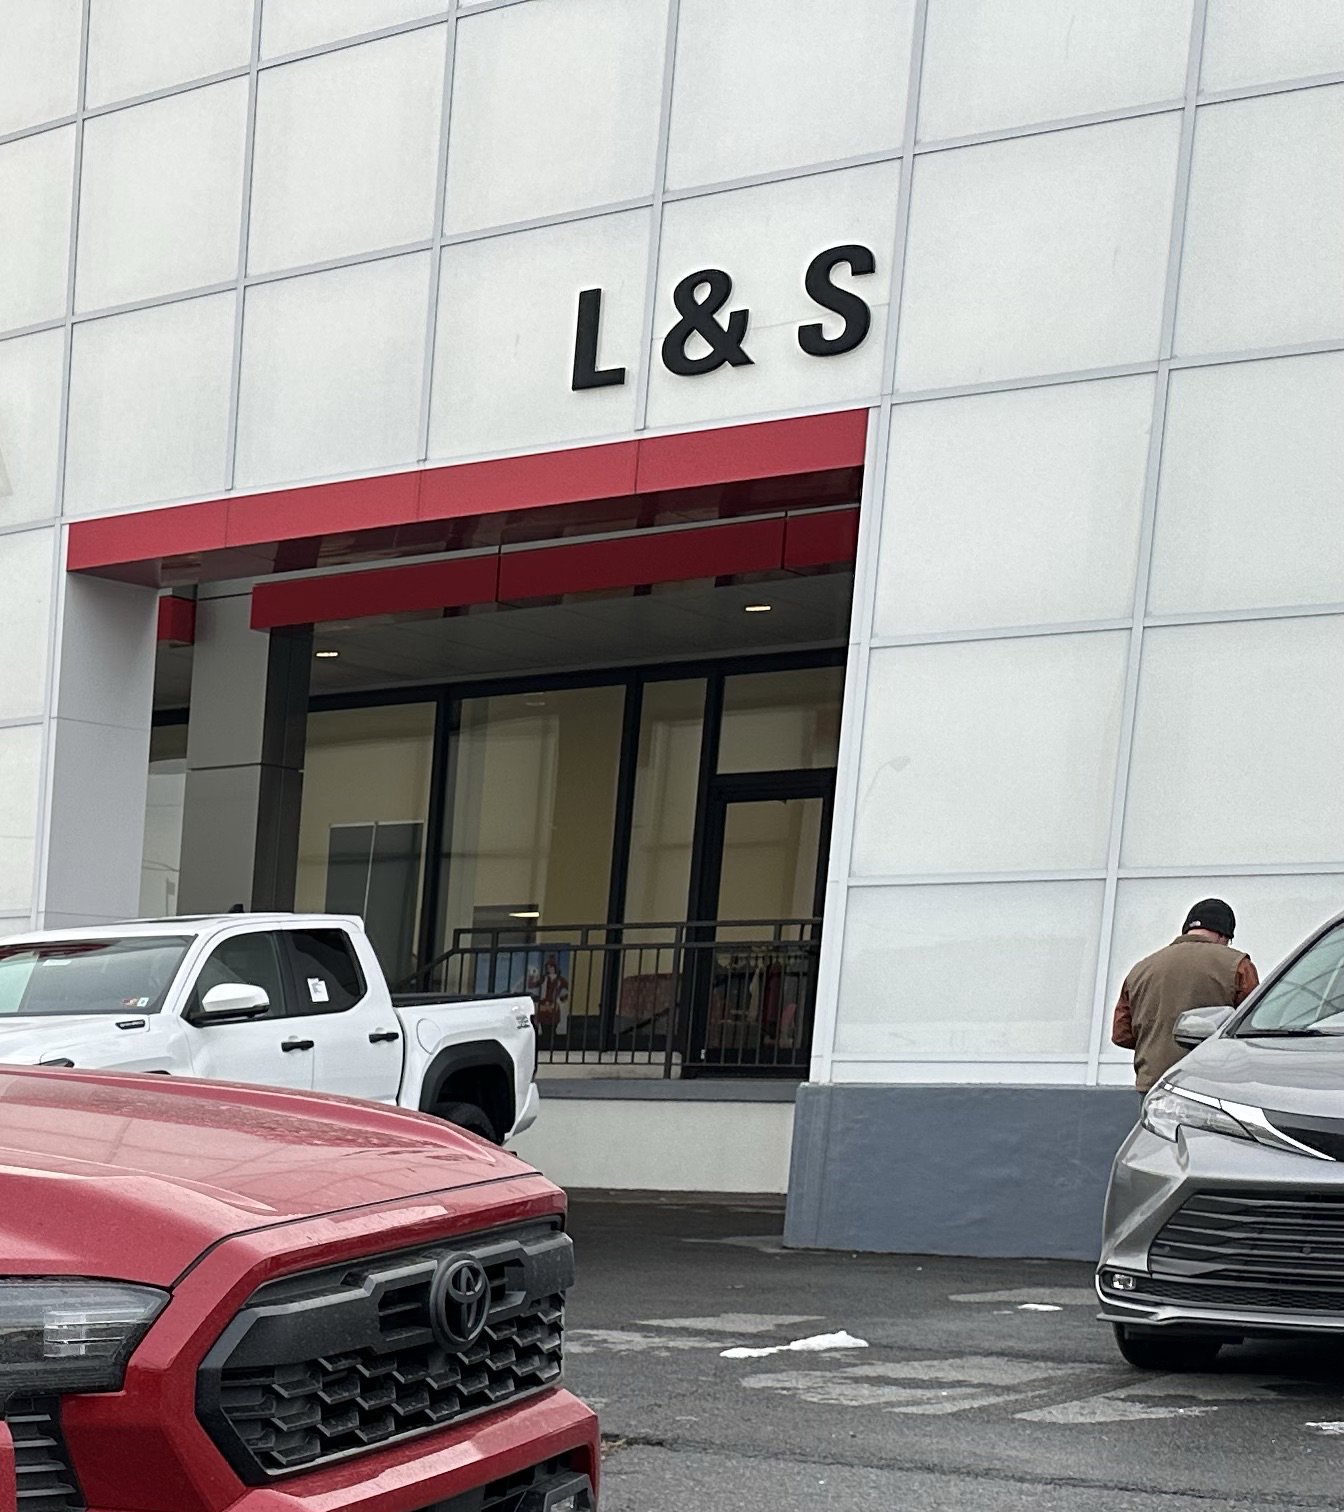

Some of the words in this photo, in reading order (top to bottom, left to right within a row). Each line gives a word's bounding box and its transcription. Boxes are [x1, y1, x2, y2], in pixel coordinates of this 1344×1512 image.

[572, 288, 626, 391] L
[661, 268, 755, 377] &
[797, 244, 876, 357] S
